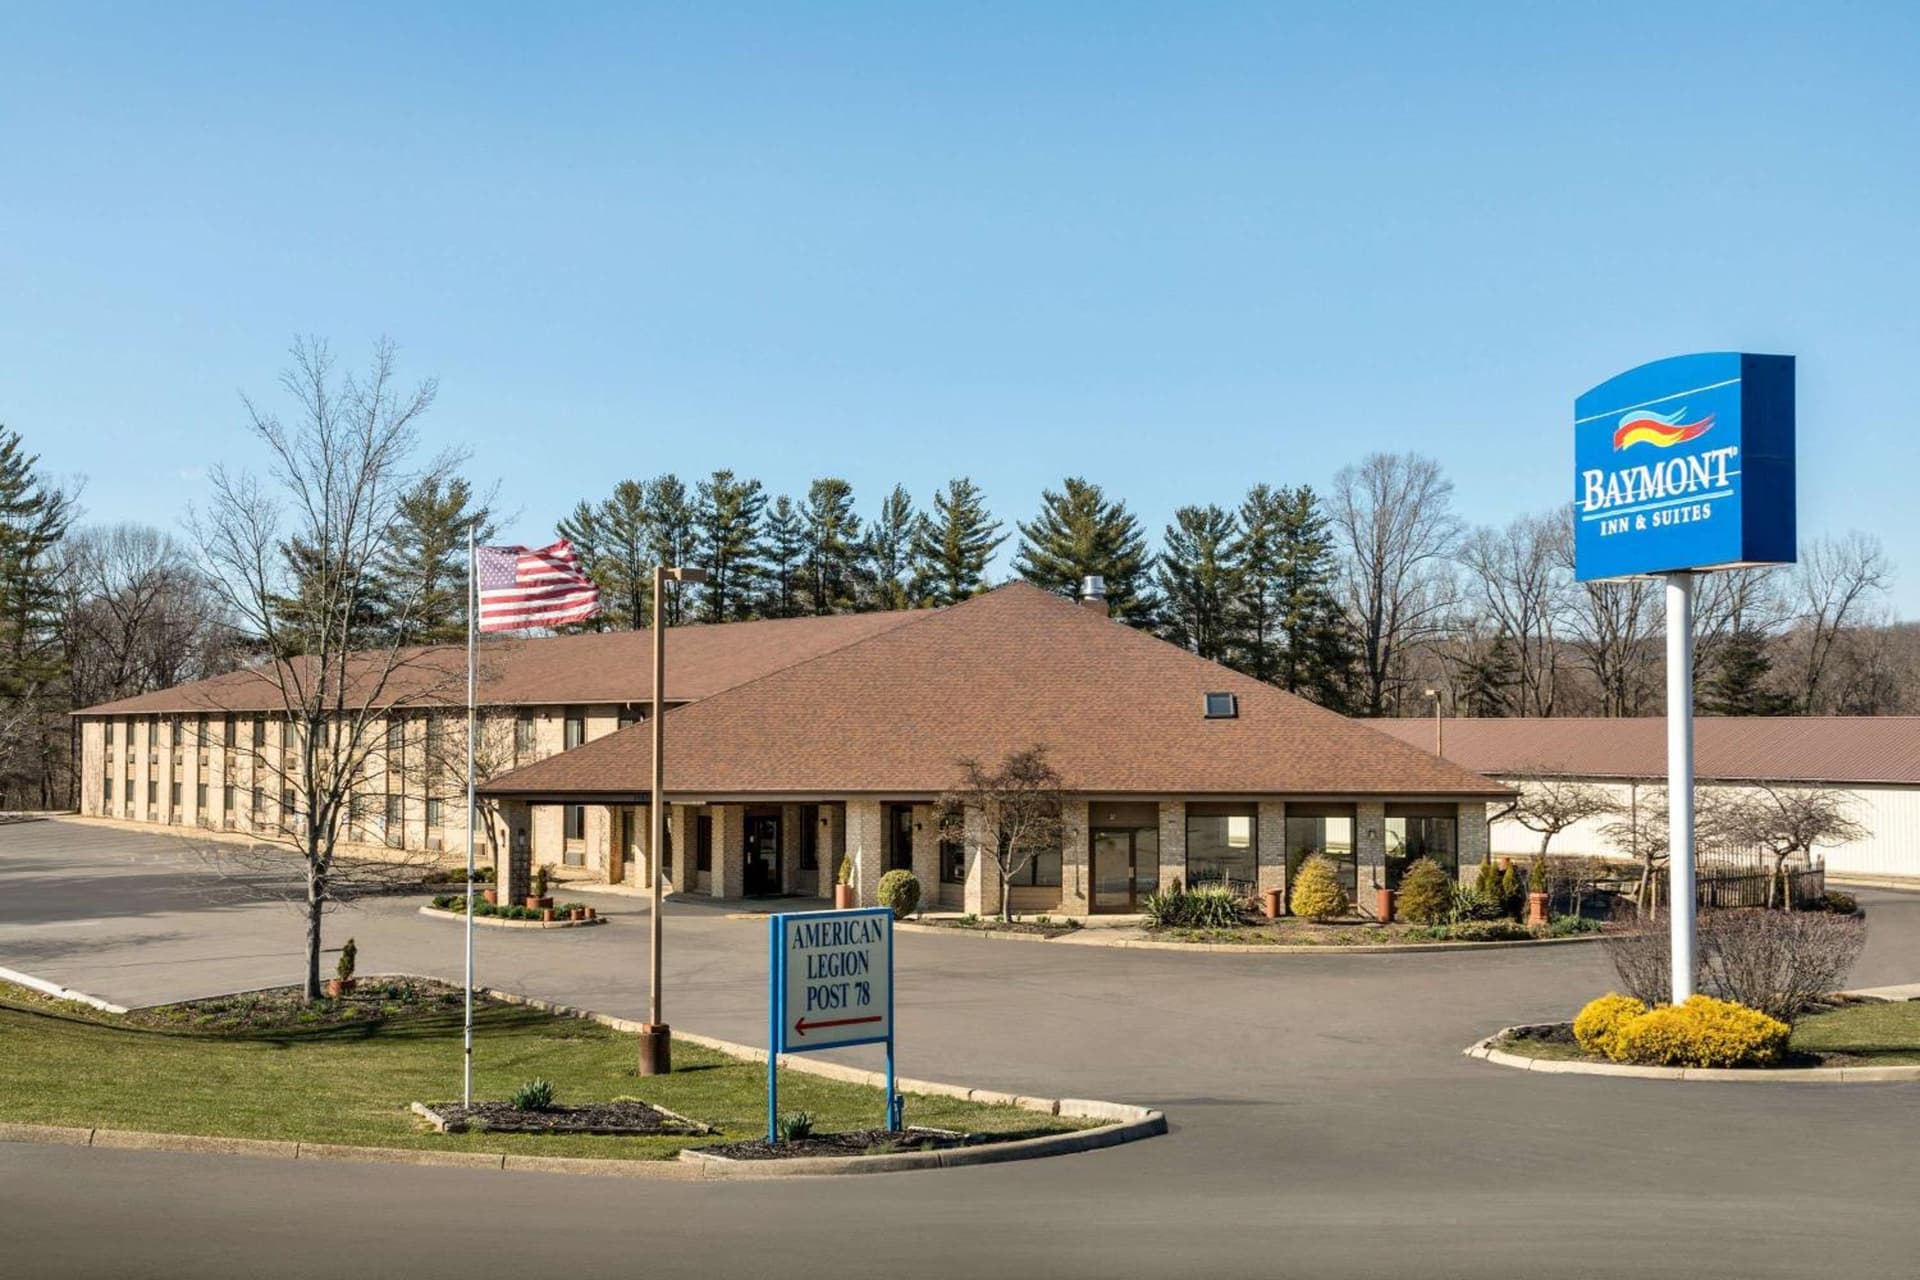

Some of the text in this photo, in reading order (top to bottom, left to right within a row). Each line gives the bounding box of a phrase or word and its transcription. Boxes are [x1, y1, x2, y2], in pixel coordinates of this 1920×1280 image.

[1582, 448, 1733, 512] BAYMONT
[1600, 503, 1712, 536] INN & SUITES
[792, 918, 883, 949] AMERICAN
[807, 950, 870, 979] LEGION
[807, 981, 871, 1011] POST 78
